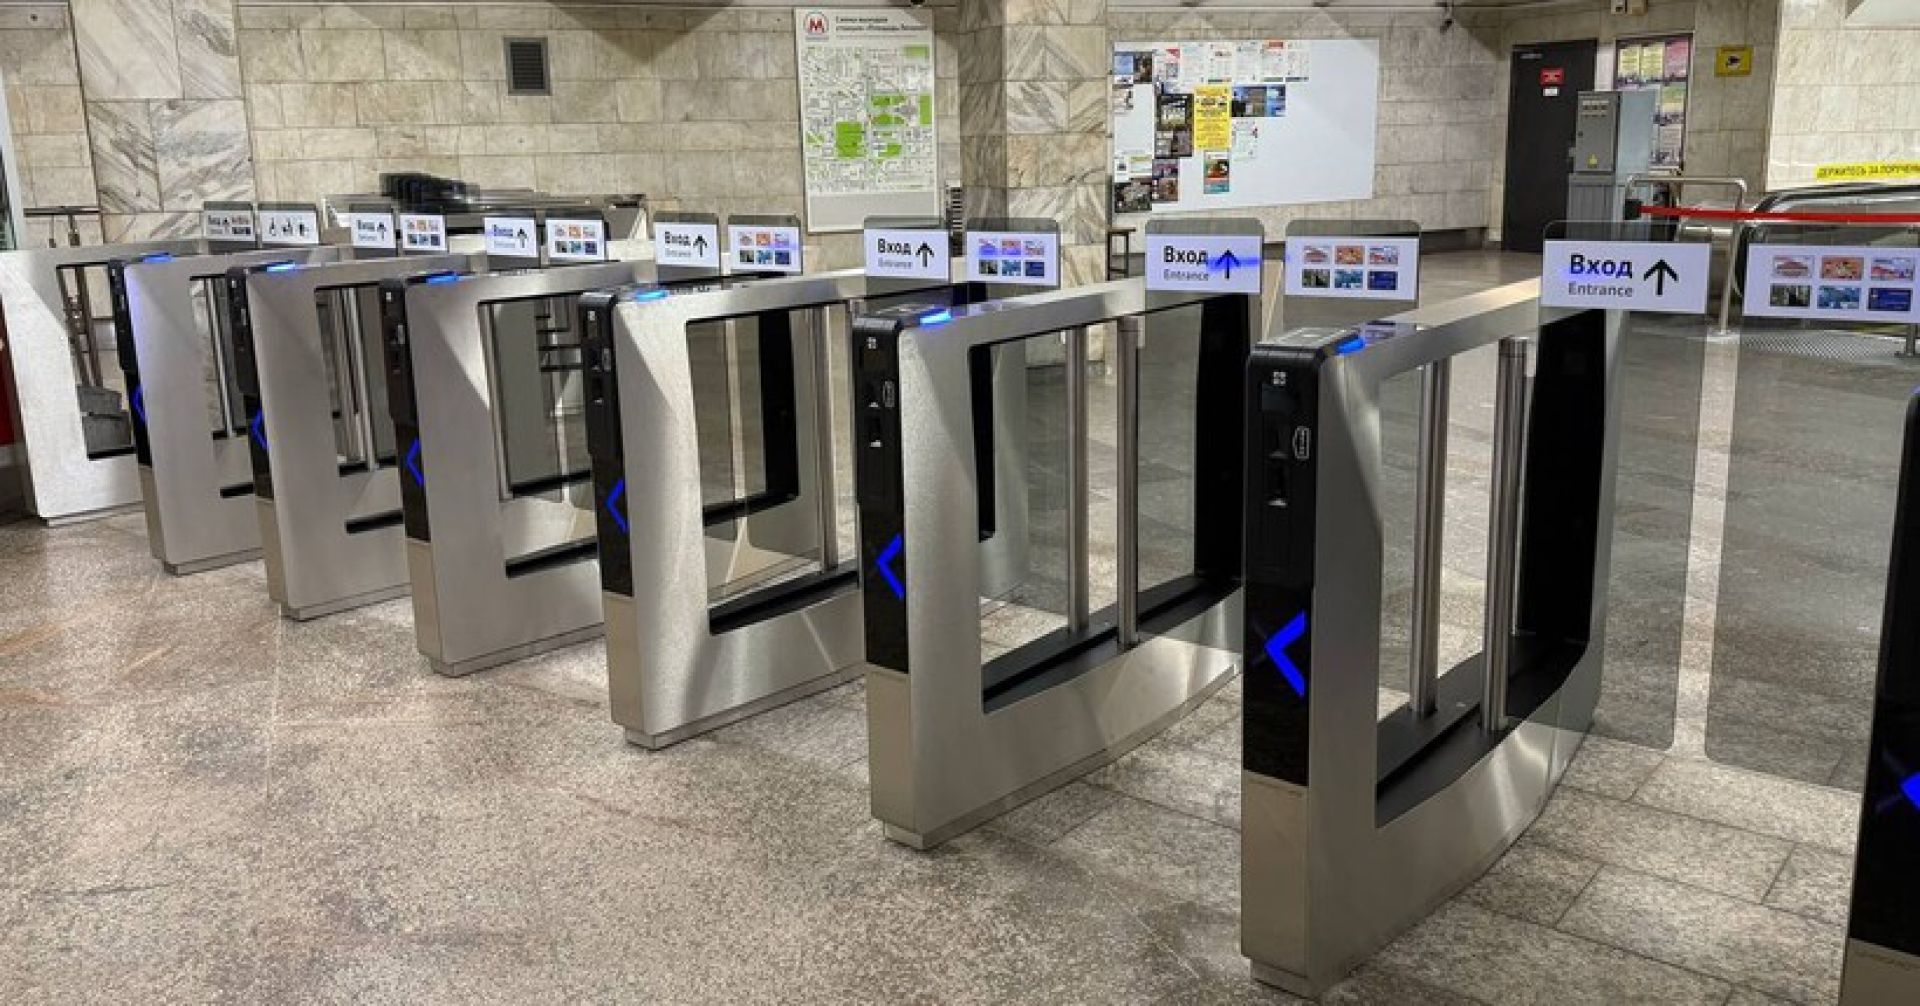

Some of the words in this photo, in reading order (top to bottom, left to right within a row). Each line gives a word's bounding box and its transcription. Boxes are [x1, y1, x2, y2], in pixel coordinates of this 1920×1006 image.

[877, 238, 912, 256] Вход
[1163, 245, 1209, 266] Вход
[1163, 269, 1209, 282] Entrance
[1570, 254, 1633, 279] Вход
[1568, 282, 1634, 297] Entrance
